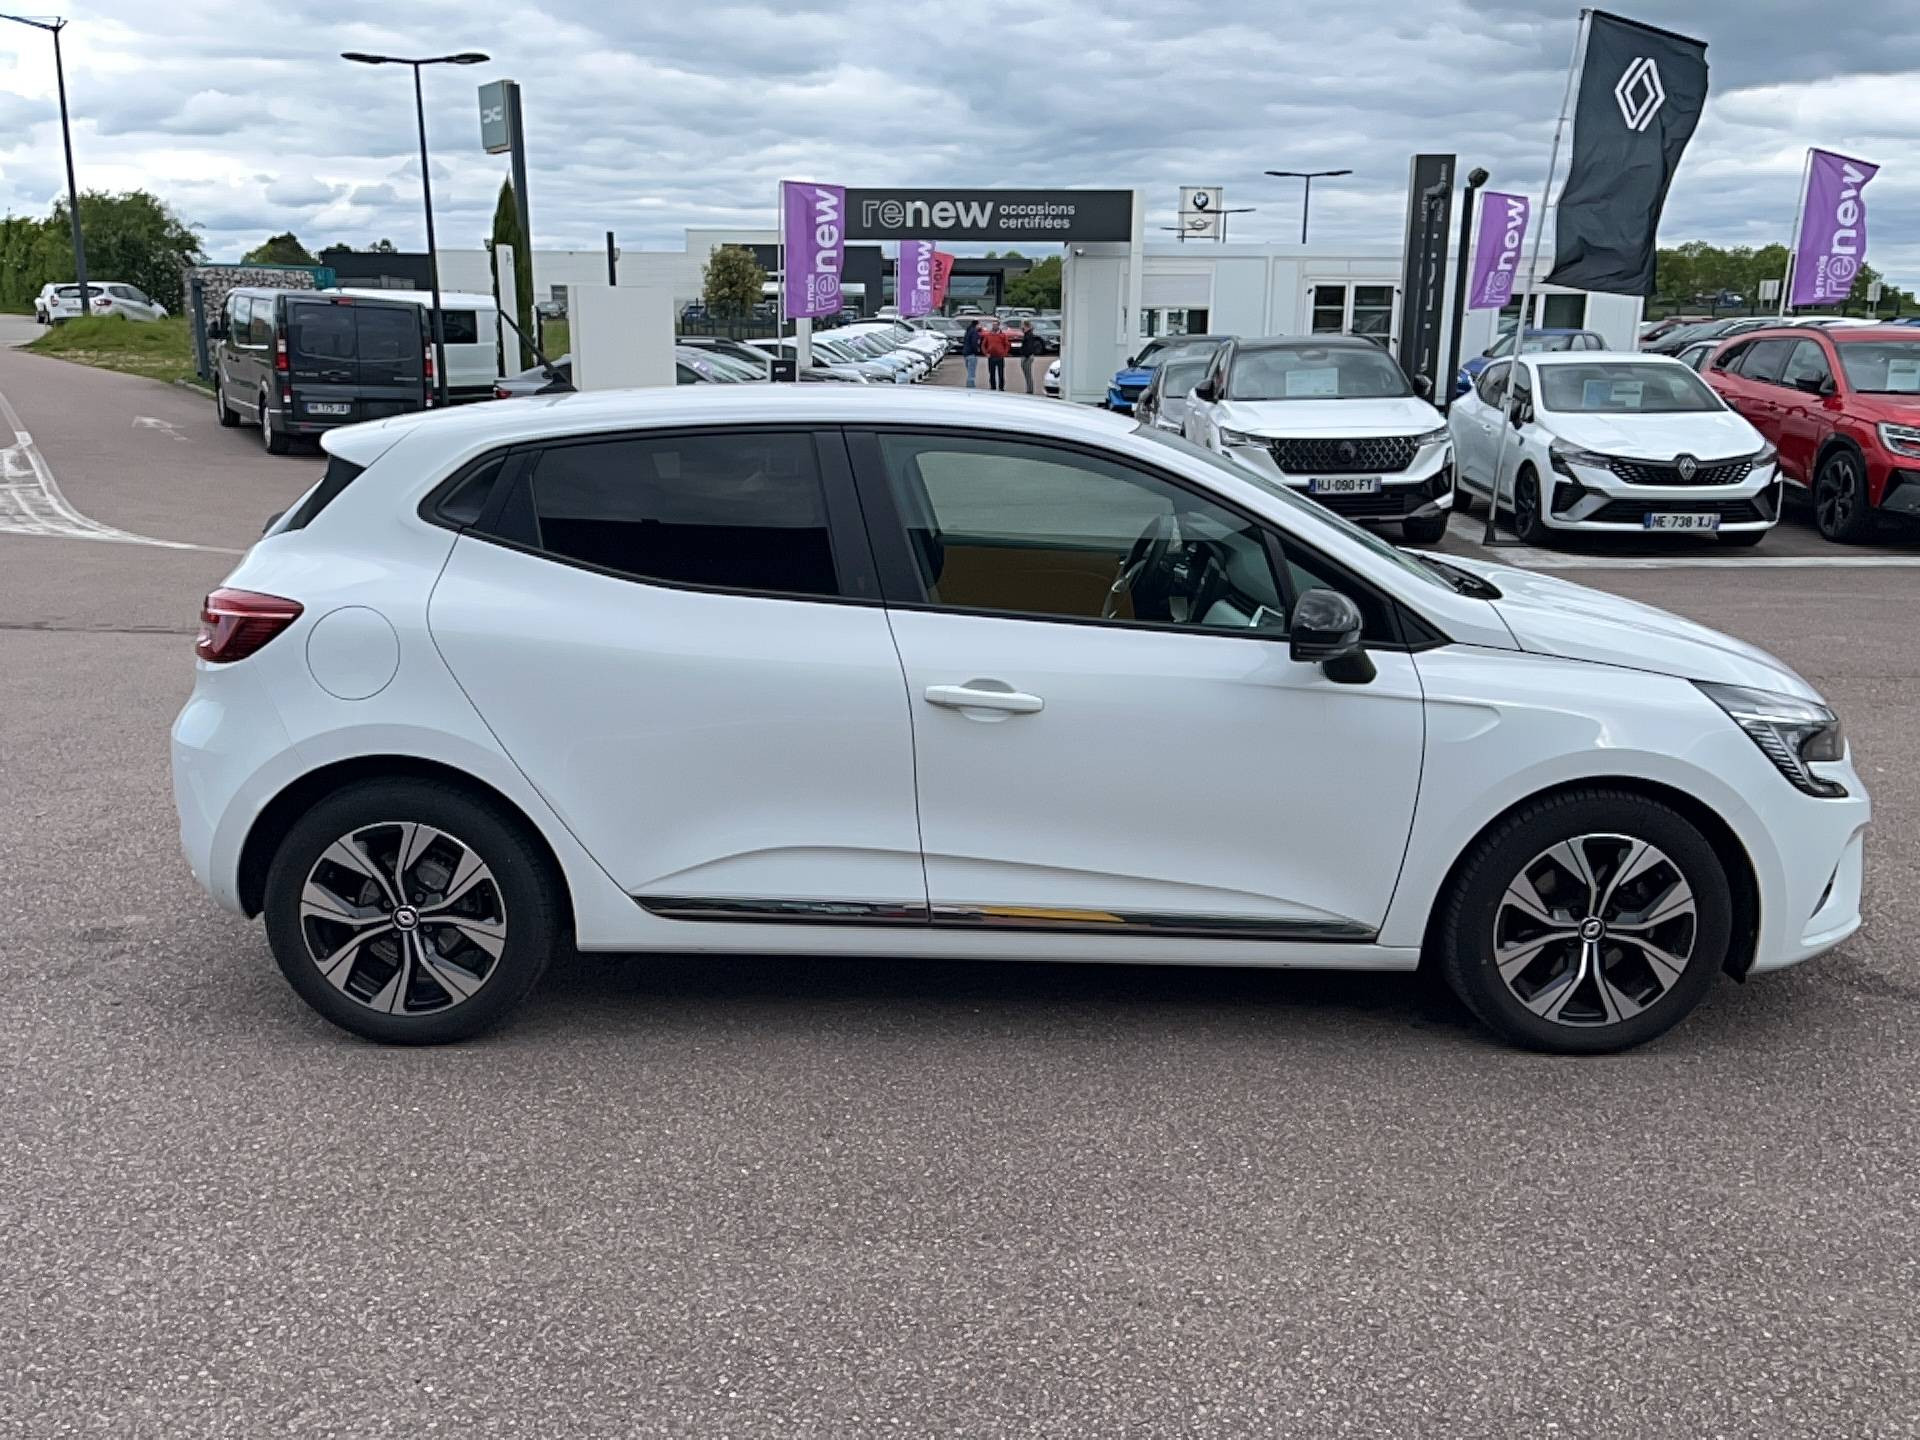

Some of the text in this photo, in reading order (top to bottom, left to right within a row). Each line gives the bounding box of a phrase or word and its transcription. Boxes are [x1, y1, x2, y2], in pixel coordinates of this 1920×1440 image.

[862, 200, 994, 228] renew
[999, 203, 1075, 215] occasions
[999, 215, 1070, 228] certifiées
[1826, 163, 1865, 297] renew
[815, 188, 839, 311] renew
[1487, 199, 1525, 303] renew
[1815, 255, 1829, 286] mois
[917, 241, 932, 313] renew
